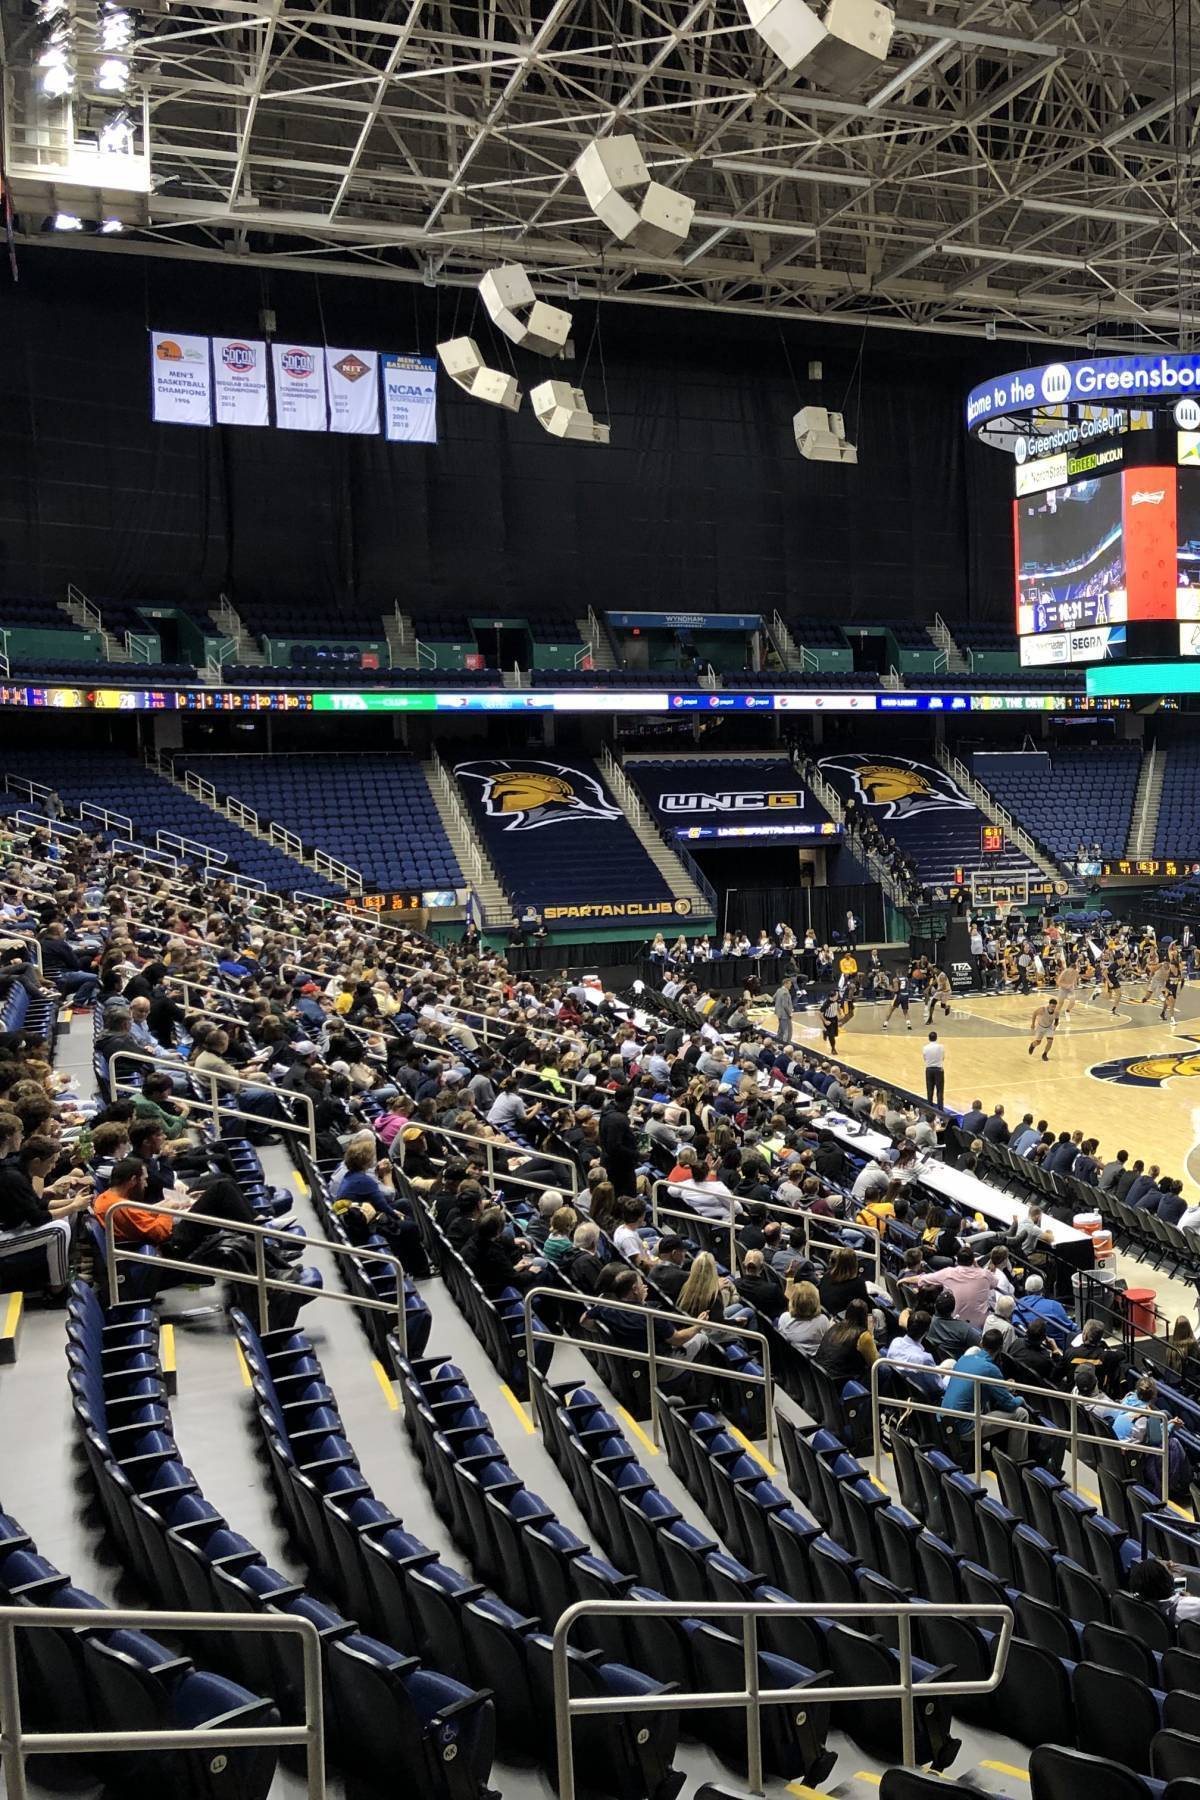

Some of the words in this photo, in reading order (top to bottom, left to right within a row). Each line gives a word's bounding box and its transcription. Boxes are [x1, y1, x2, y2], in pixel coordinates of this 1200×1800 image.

[169, 370, 194, 379] MEN'S
[342, 364, 362, 373] NIT
[158, 377, 206, 388] BASKETBALL
[158, 386, 207, 397] CHAMPIONS
[388, 384, 422, 396] NCAA
[994, 387, 1006, 407] to
[1010, 377, 1035, 402] the
[1027, 428, 1079, 454] Greensboro
[1080, 411, 1123, 437] Coliseum
[1096, 448, 1123, 466] LINCOLN
[665, 615, 704, 623] WYNDHAM
[1072, 636, 1103, 650] SEGRA
[664, 793, 802, 811] UNCG
[985, 836, 1000, 849] 30
[544, 903, 626, 919] SPARTAN
[627, 902, 672, 916] CLUB
[950, 962, 972, 971] TFA
